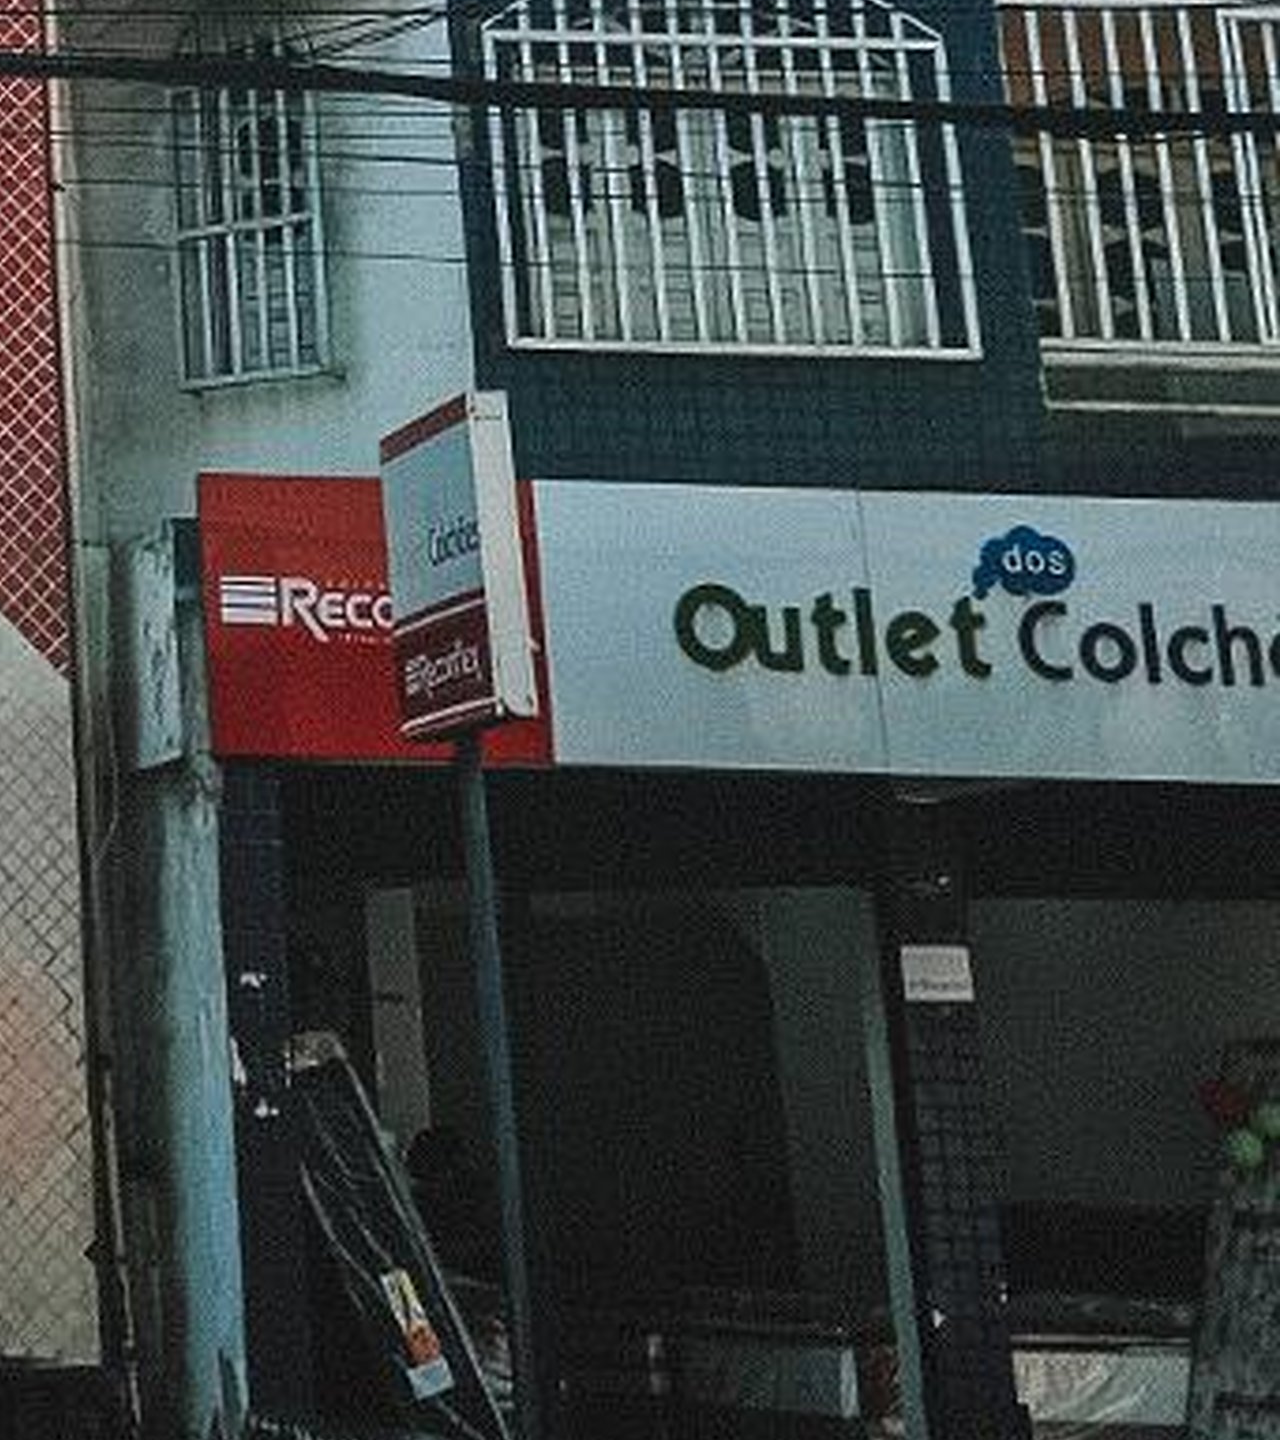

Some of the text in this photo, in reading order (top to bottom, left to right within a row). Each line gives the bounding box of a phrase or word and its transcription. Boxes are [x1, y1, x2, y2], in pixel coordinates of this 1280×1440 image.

[1001, 544, 1066, 575] dos
[673, 582, 1280, 687] Outlet Colch
